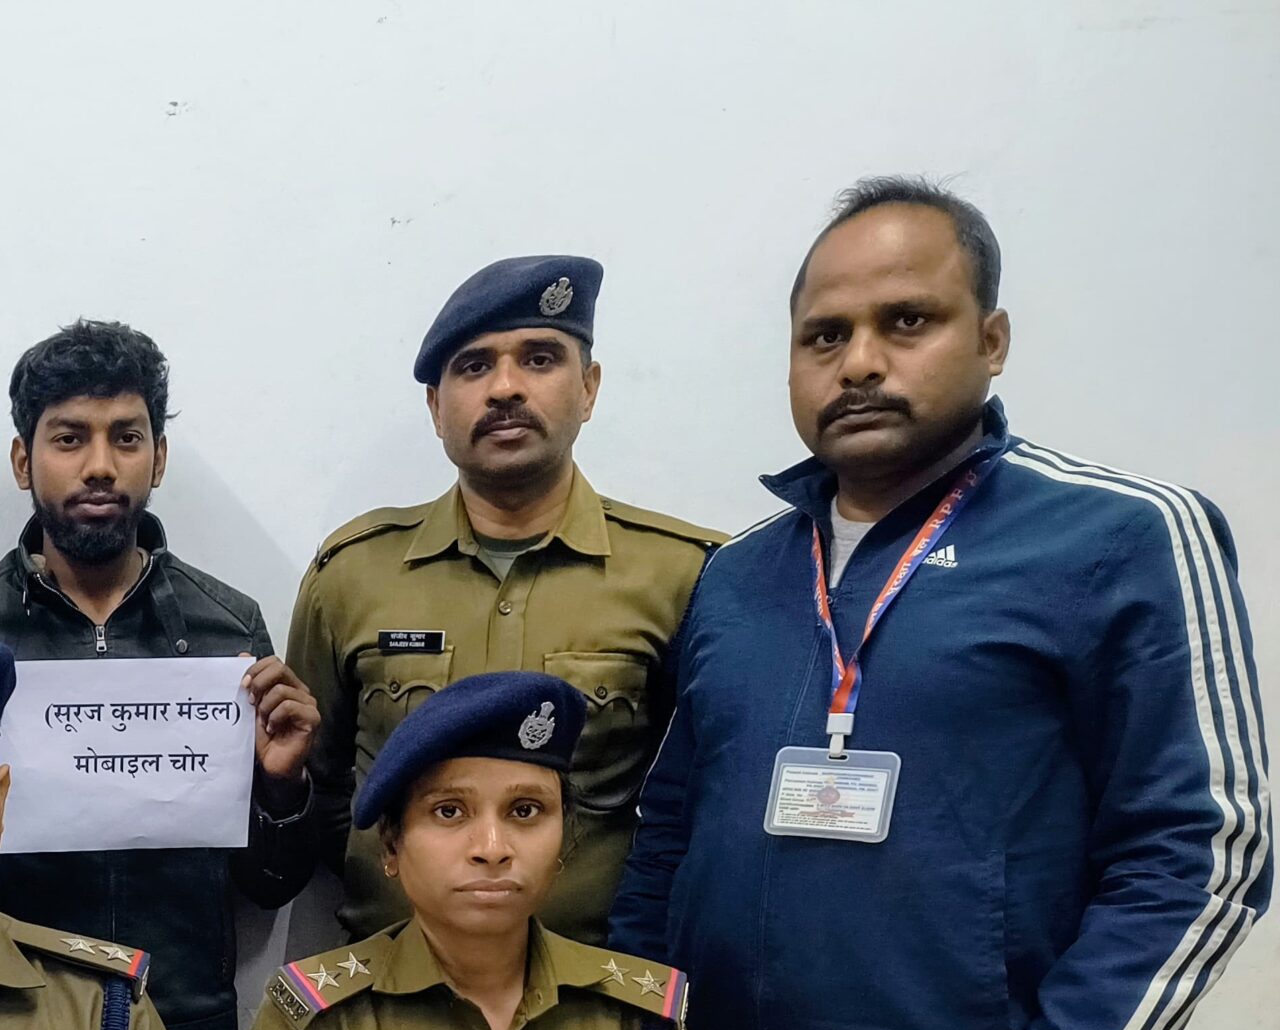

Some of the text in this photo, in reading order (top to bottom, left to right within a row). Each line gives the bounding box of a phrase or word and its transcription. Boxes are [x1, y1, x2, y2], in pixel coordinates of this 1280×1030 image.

[44, 697, 241, 733] (सूरज कुमार मंडल)
[73, 745, 209, 778] मोबाइल चोर
